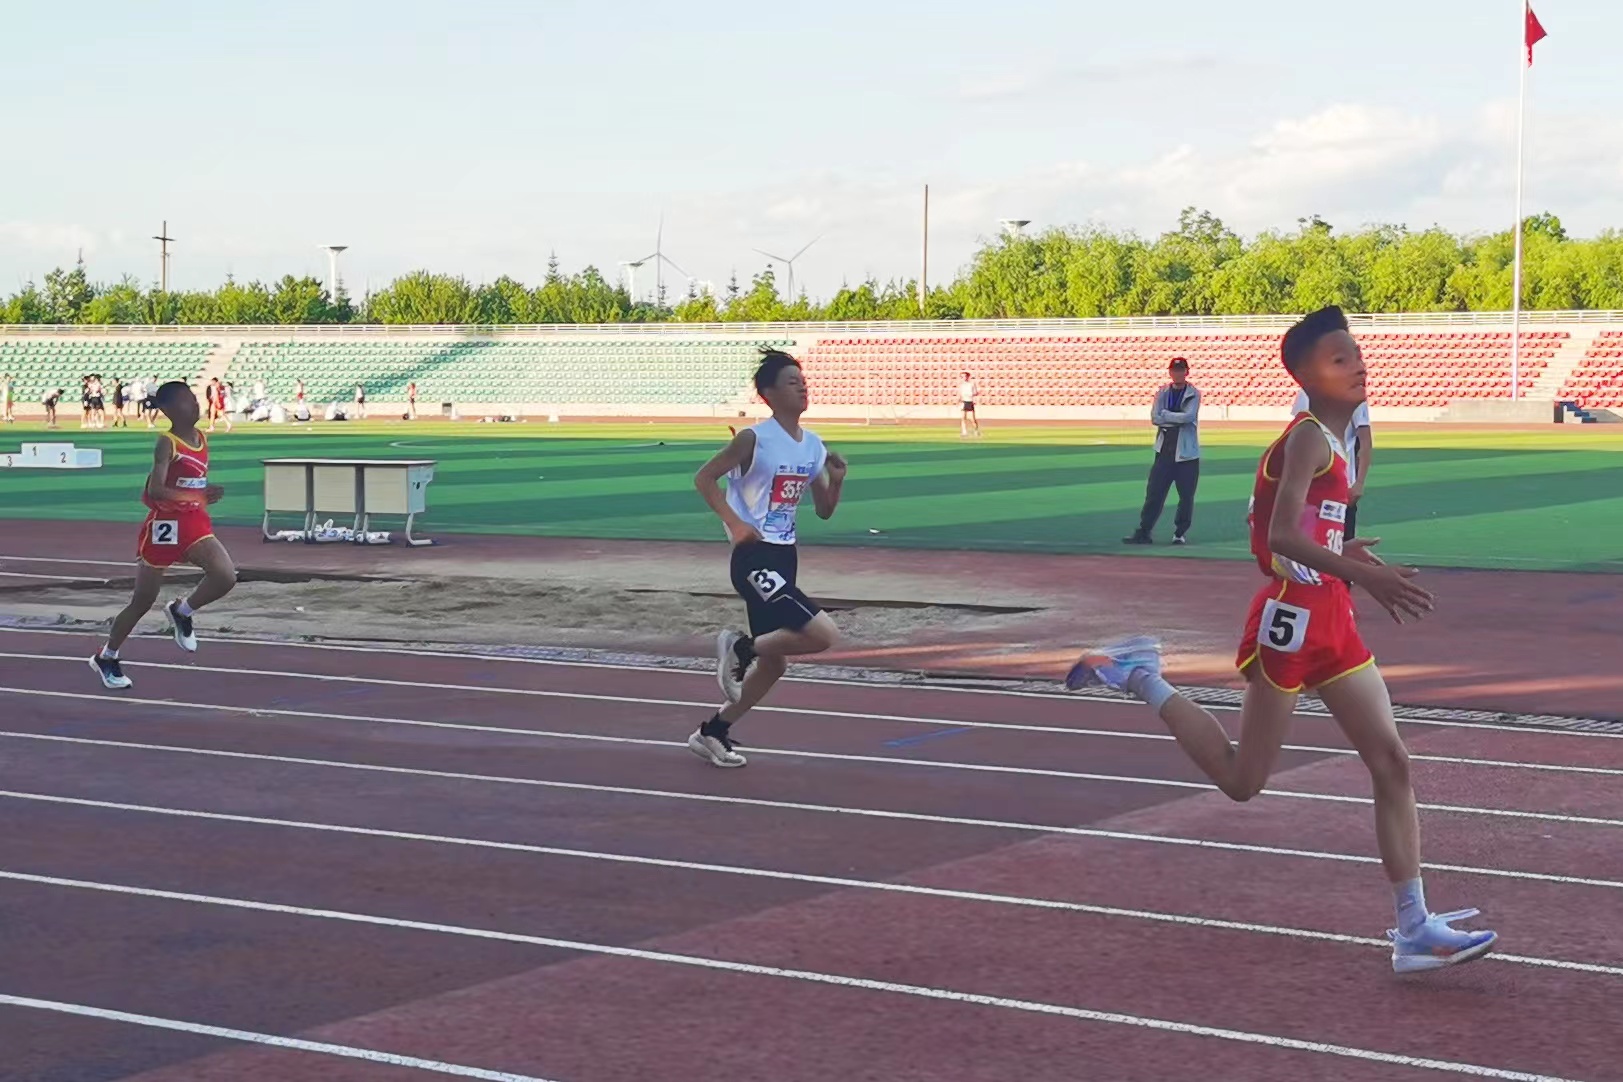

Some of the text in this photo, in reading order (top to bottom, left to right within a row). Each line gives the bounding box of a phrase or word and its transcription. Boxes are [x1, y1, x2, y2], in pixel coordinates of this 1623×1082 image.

[8, 456, 13, 467] 3
[60, 452, 66, 463] 2
[157, 523, 172, 542] 2
[754, 571, 776, 593] 3
[1269, 608, 1297, 646] 5
